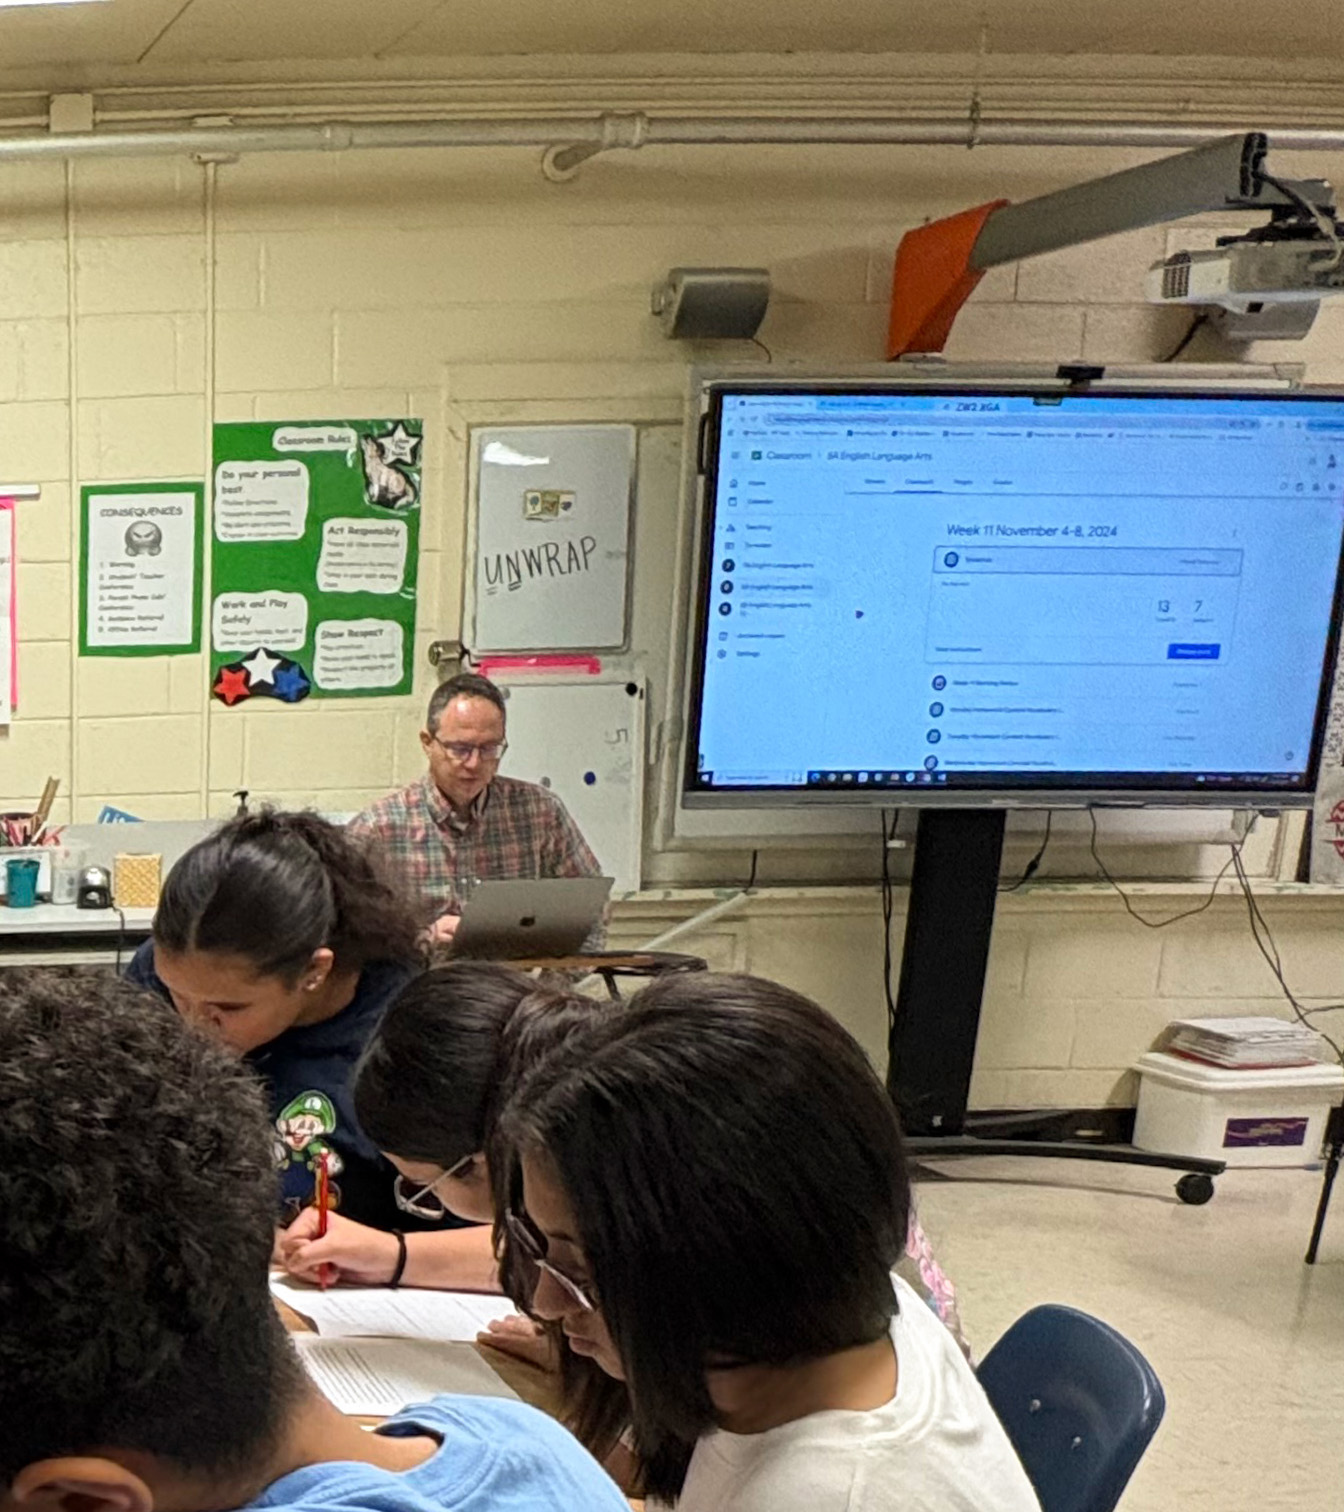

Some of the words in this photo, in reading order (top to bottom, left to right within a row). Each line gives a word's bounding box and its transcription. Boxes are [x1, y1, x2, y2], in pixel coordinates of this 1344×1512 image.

[766, 450, 812, 461] Classroom
[840, 450, 871, 463] English
[872, 450, 913, 463] Language
[914, 451, 932, 462] Arts
[221, 469, 236, 480] Do
[238, 470, 259, 481] your
[262, 467, 302, 480] personal
[99, 505, 183, 518] CONSEQUENCES
[327, 526, 346, 536] Act
[348, 525, 400, 539] Responsibly
[946, 523, 980, 537] Week
[996, 523, 1059, 538] November
[1087, 524, 1118, 538] 2024
[483, 535, 598, 588] UNWRAP
[220, 600, 247, 610] Work
[249, 599, 268, 609] and
[269, 598, 289, 610] Play
[1157, 599, 1171, 613] 13
[321, 629, 345, 640] Show
[348, 628, 385, 639] Respect
